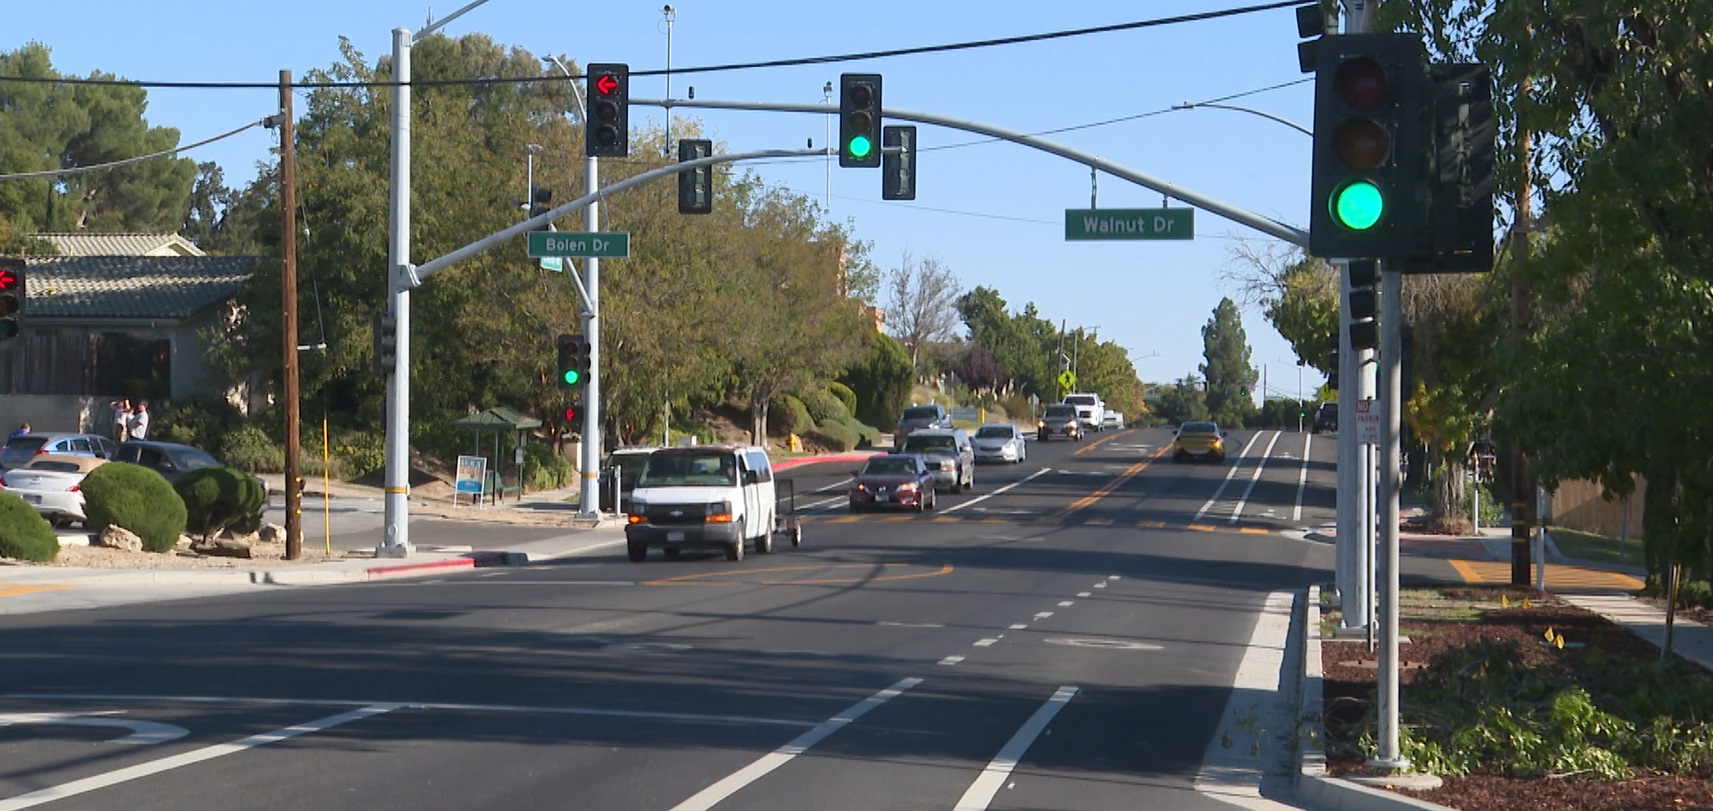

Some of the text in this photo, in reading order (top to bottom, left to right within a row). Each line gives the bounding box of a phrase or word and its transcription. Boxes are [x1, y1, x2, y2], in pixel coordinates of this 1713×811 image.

[1083, 216, 1175, 233] Walnut Dr
[546, 238, 610, 252] Bolen Dr
[1357, 402, 1368, 411] NO
[1357, 415, 1380, 423] PARKIN
